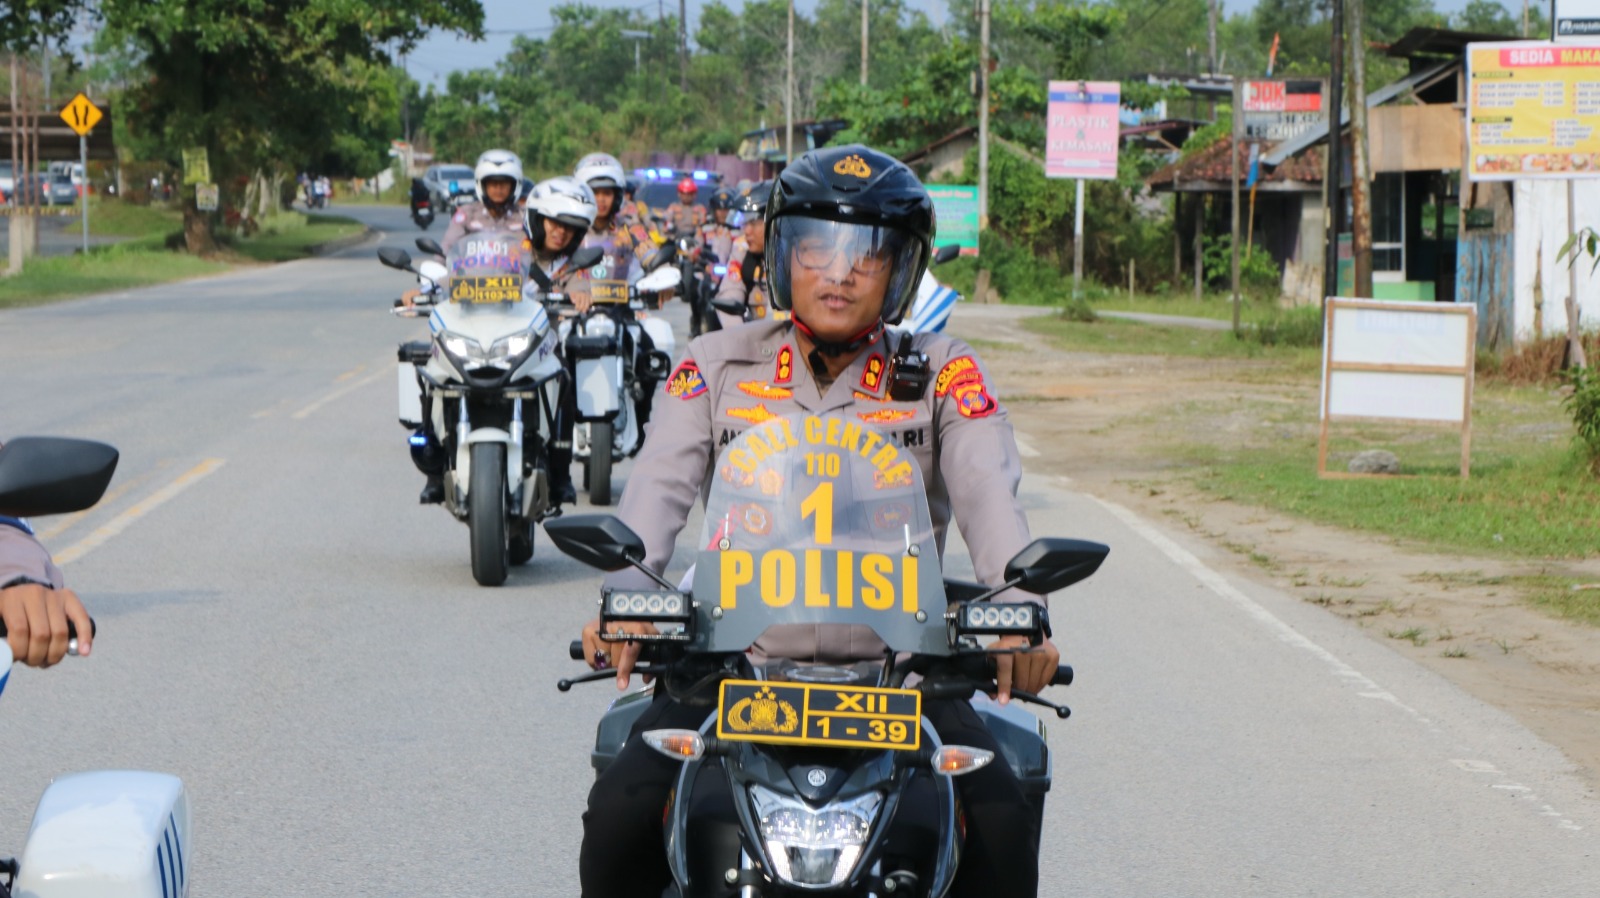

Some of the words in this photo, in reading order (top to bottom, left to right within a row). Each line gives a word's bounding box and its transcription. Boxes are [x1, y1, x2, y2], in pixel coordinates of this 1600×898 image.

[1509, 49, 1555, 65] SEDIA
[1249, 81, 1285, 103] JOK
[1052, 114, 1110, 129] PLASTIK
[1051, 140, 1115, 154] KEMASAN
[452, 254, 520, 274] POLISI
[485, 276, 513, 288] XII
[728, 418, 799, 474] CALL
[804, 415, 913, 484] CENTRE
[804, 451, 841, 478] 110
[800, 481, 834, 545] 1
[720, 549, 919, 614] POLISI
[834, 691, 888, 714] XII
[816, 716, 831, 739] 1
[867, 719, 908, 743] 39
